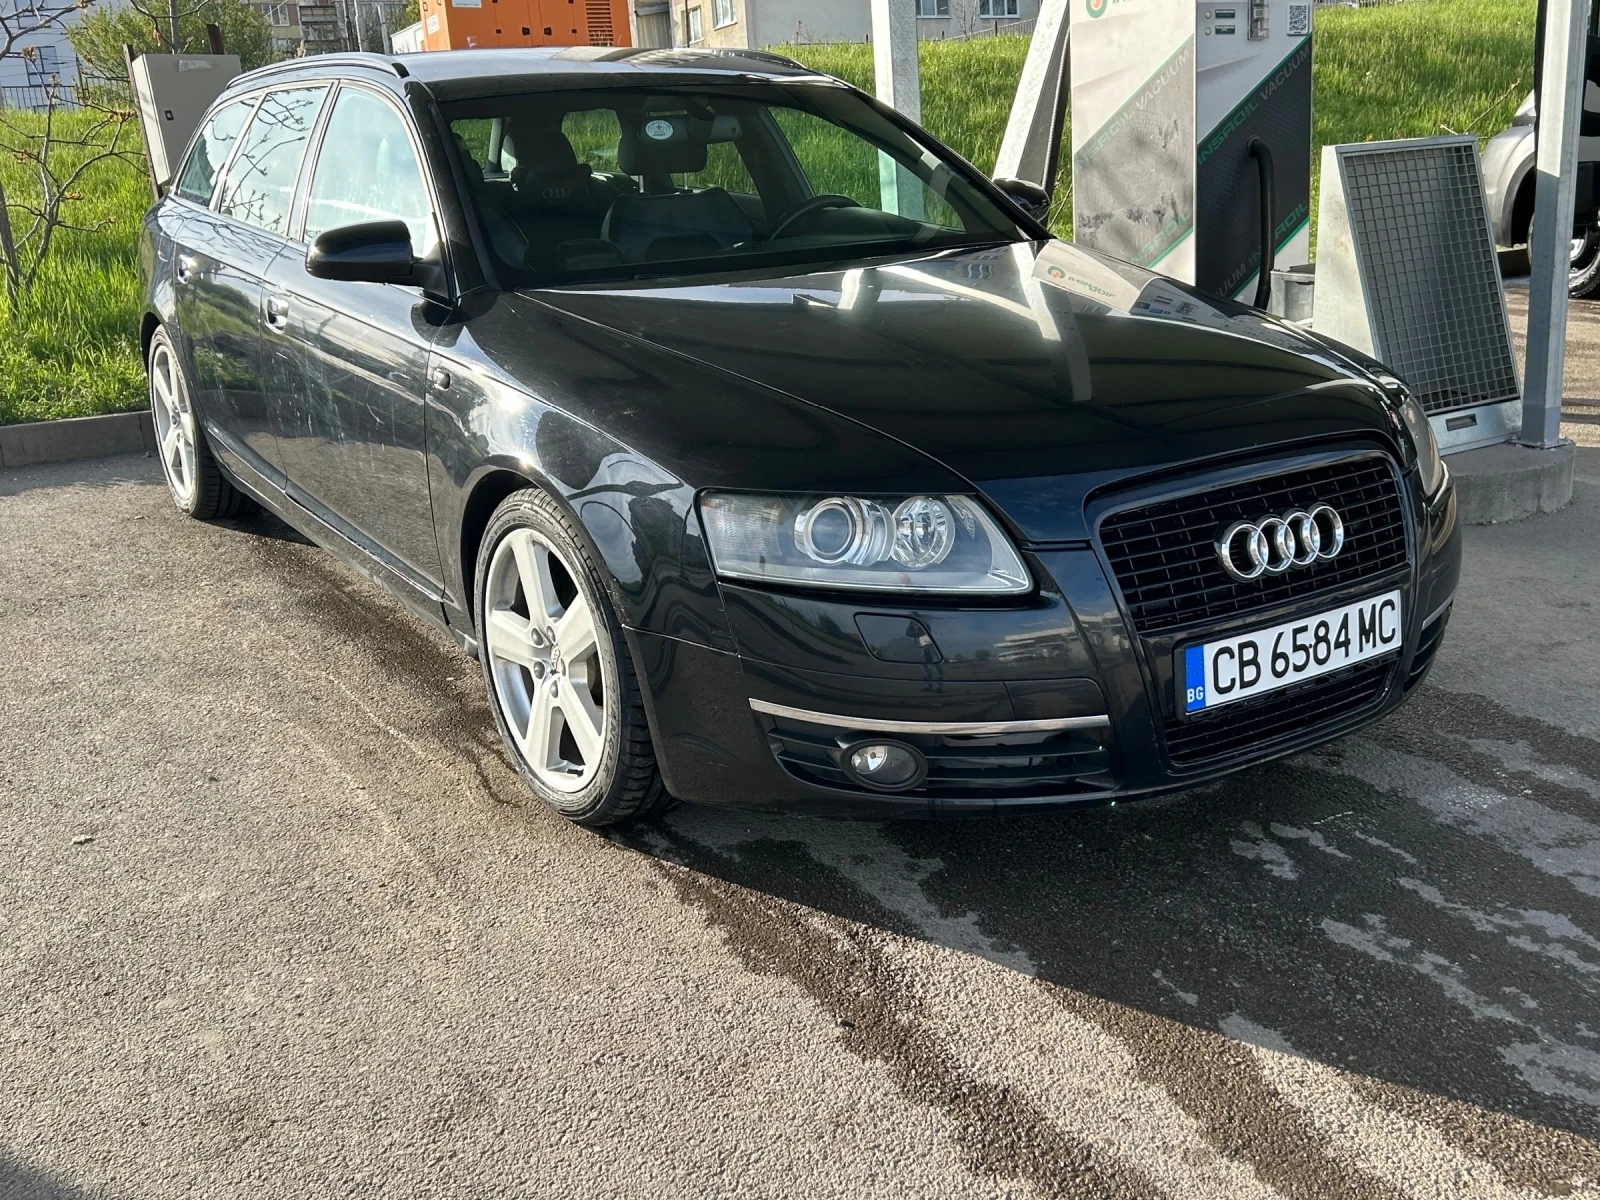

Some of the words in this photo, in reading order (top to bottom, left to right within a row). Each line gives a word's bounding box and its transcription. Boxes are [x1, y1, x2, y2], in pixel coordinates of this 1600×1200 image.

[1136, 50, 1190, 110] VACUUM
[1197, 101, 1259, 166] INSAOIL
[1260, 44, 1310, 100] VACUUM
[1130, 212, 1190, 265] NSAOIL
[1212, 640, 1262, 695] CB
[1270, 612, 1351, 679] 6584
[1358, 598, 1396, 653] MC
[1186, 686, 1204, 703] BG
